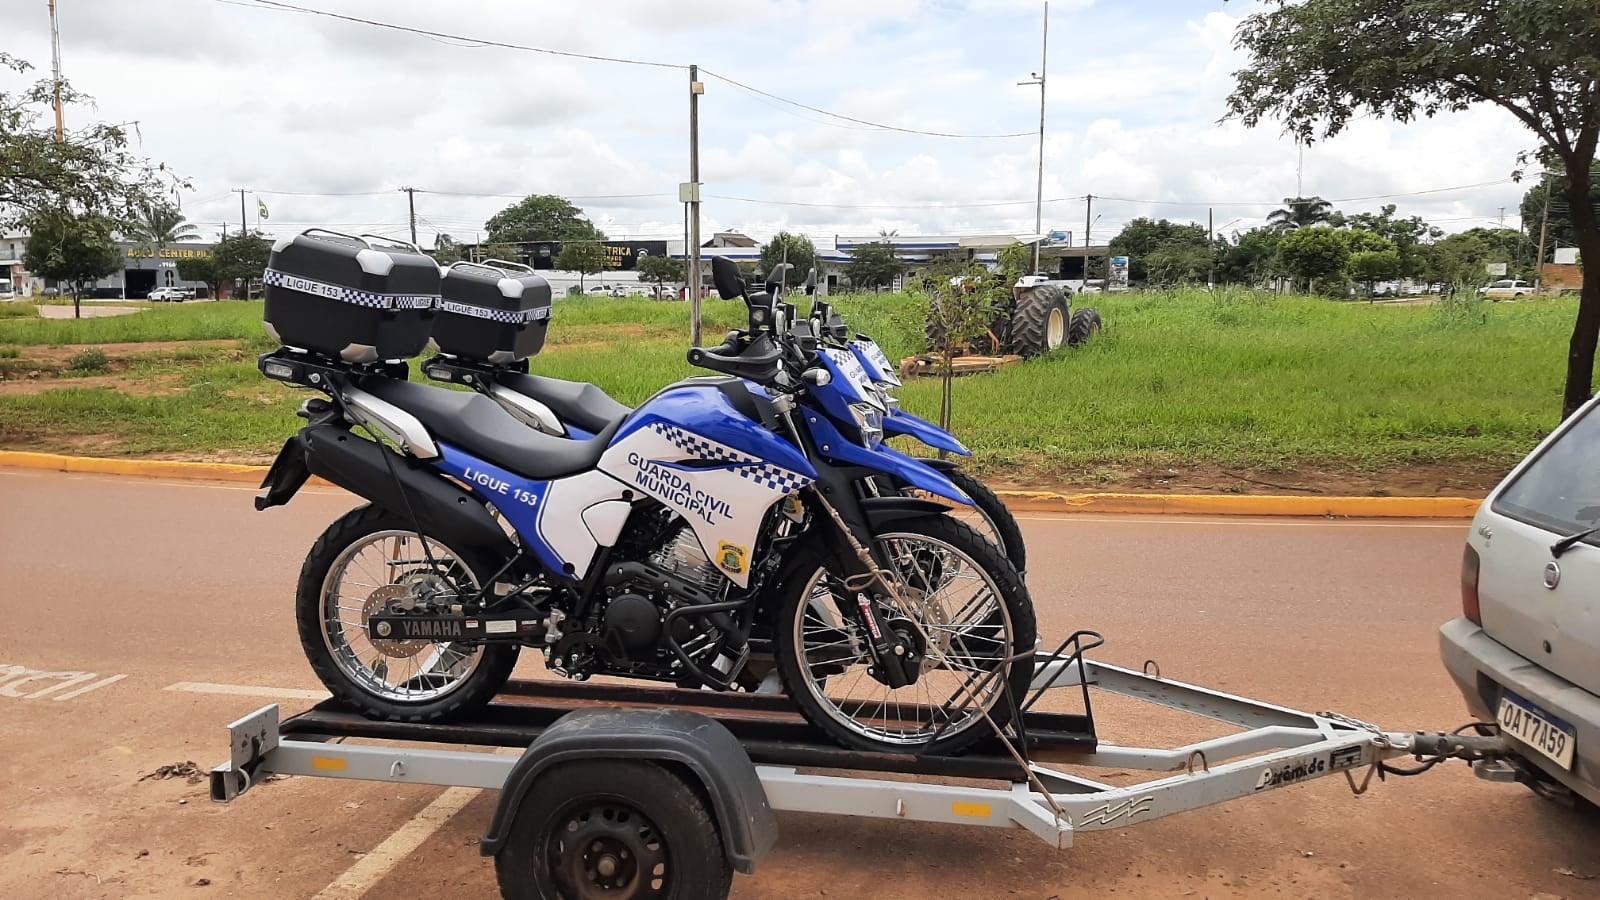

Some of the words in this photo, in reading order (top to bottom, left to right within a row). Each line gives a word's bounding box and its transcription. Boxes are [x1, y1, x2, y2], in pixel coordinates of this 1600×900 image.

[159, 249, 194, 258] CENTER
[286, 278, 318, 293] LIGUE
[321, 286, 339, 298] 153
[447, 303, 473, 315] LIGUE
[474, 307, 489, 318] 153
[463, 467, 511, 495] LIGUE
[513, 488, 538, 506] 153
[627, 451, 692, 497] GUARDA
[695, 490, 734, 520] CIVIL
[635, 470, 716, 526] MUNICIPAL
[402, 620, 462, 637] YAMAHA
[1503, 703, 1566, 759] OAT7A59
